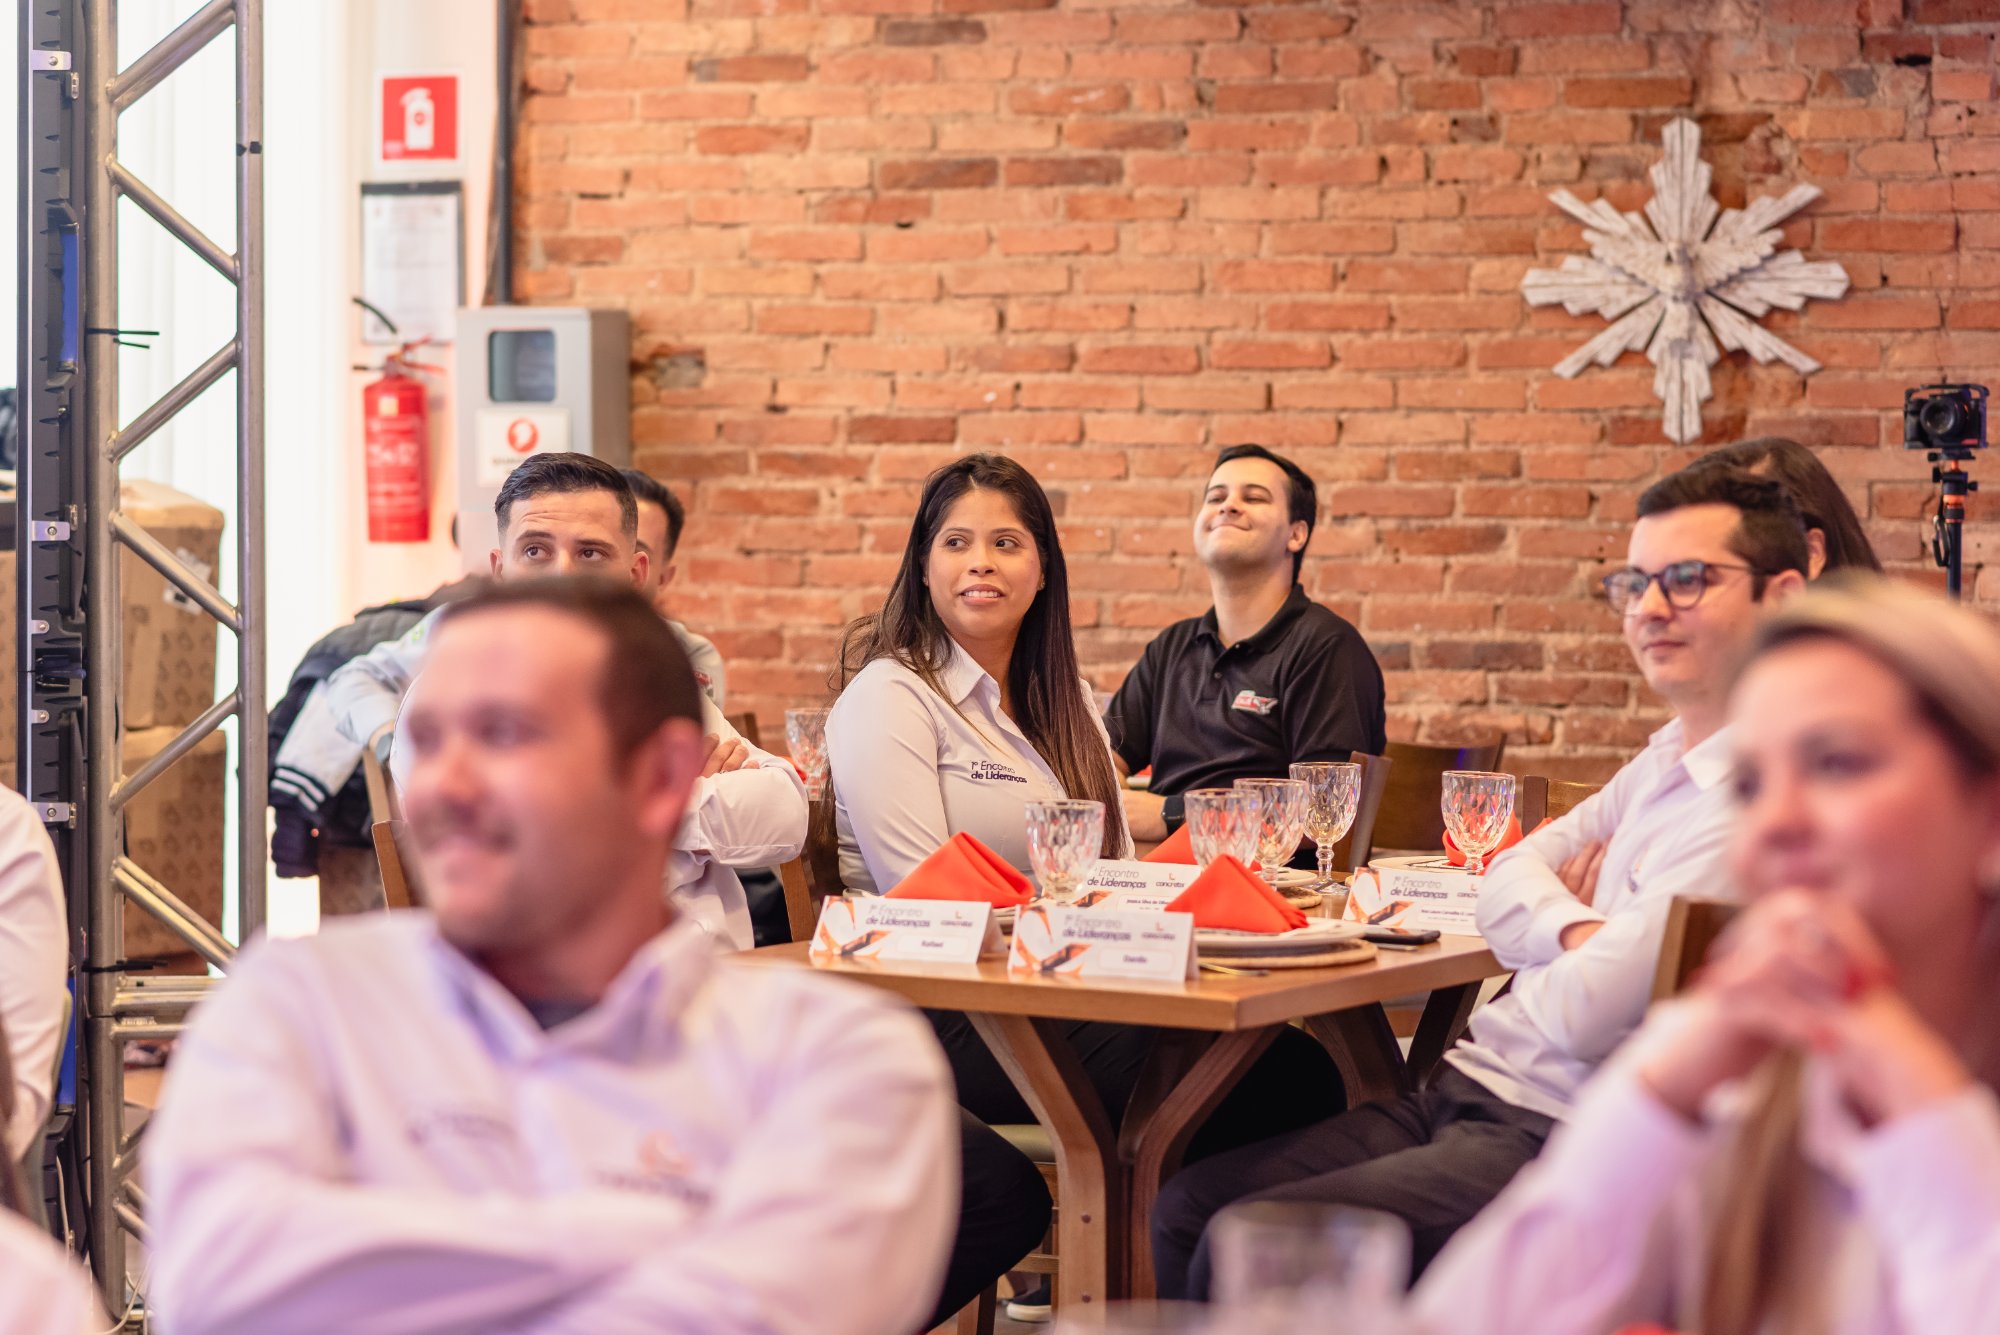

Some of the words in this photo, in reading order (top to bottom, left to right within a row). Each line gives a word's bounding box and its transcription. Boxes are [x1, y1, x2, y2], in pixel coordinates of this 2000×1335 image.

[971, 771, 984, 780] de
[985, 771, 1028, 783] Lideranças
[1097, 866, 1140, 879] Encontro
[1087, 877, 1098, 886] de
[1100, 877, 1147, 889] Lideranças
[1401, 876, 1442, 889] Encontro
[1390, 887, 1402, 896] de
[1403, 888, 1449, 899] Lideranças
[879, 905, 923, 917] Encontro
[866, 916, 878, 925] de
[880, 916, 931, 928] Lideranças
[1062, 928, 1075, 937] de
[1077, 928, 1132, 941] Lideranças
